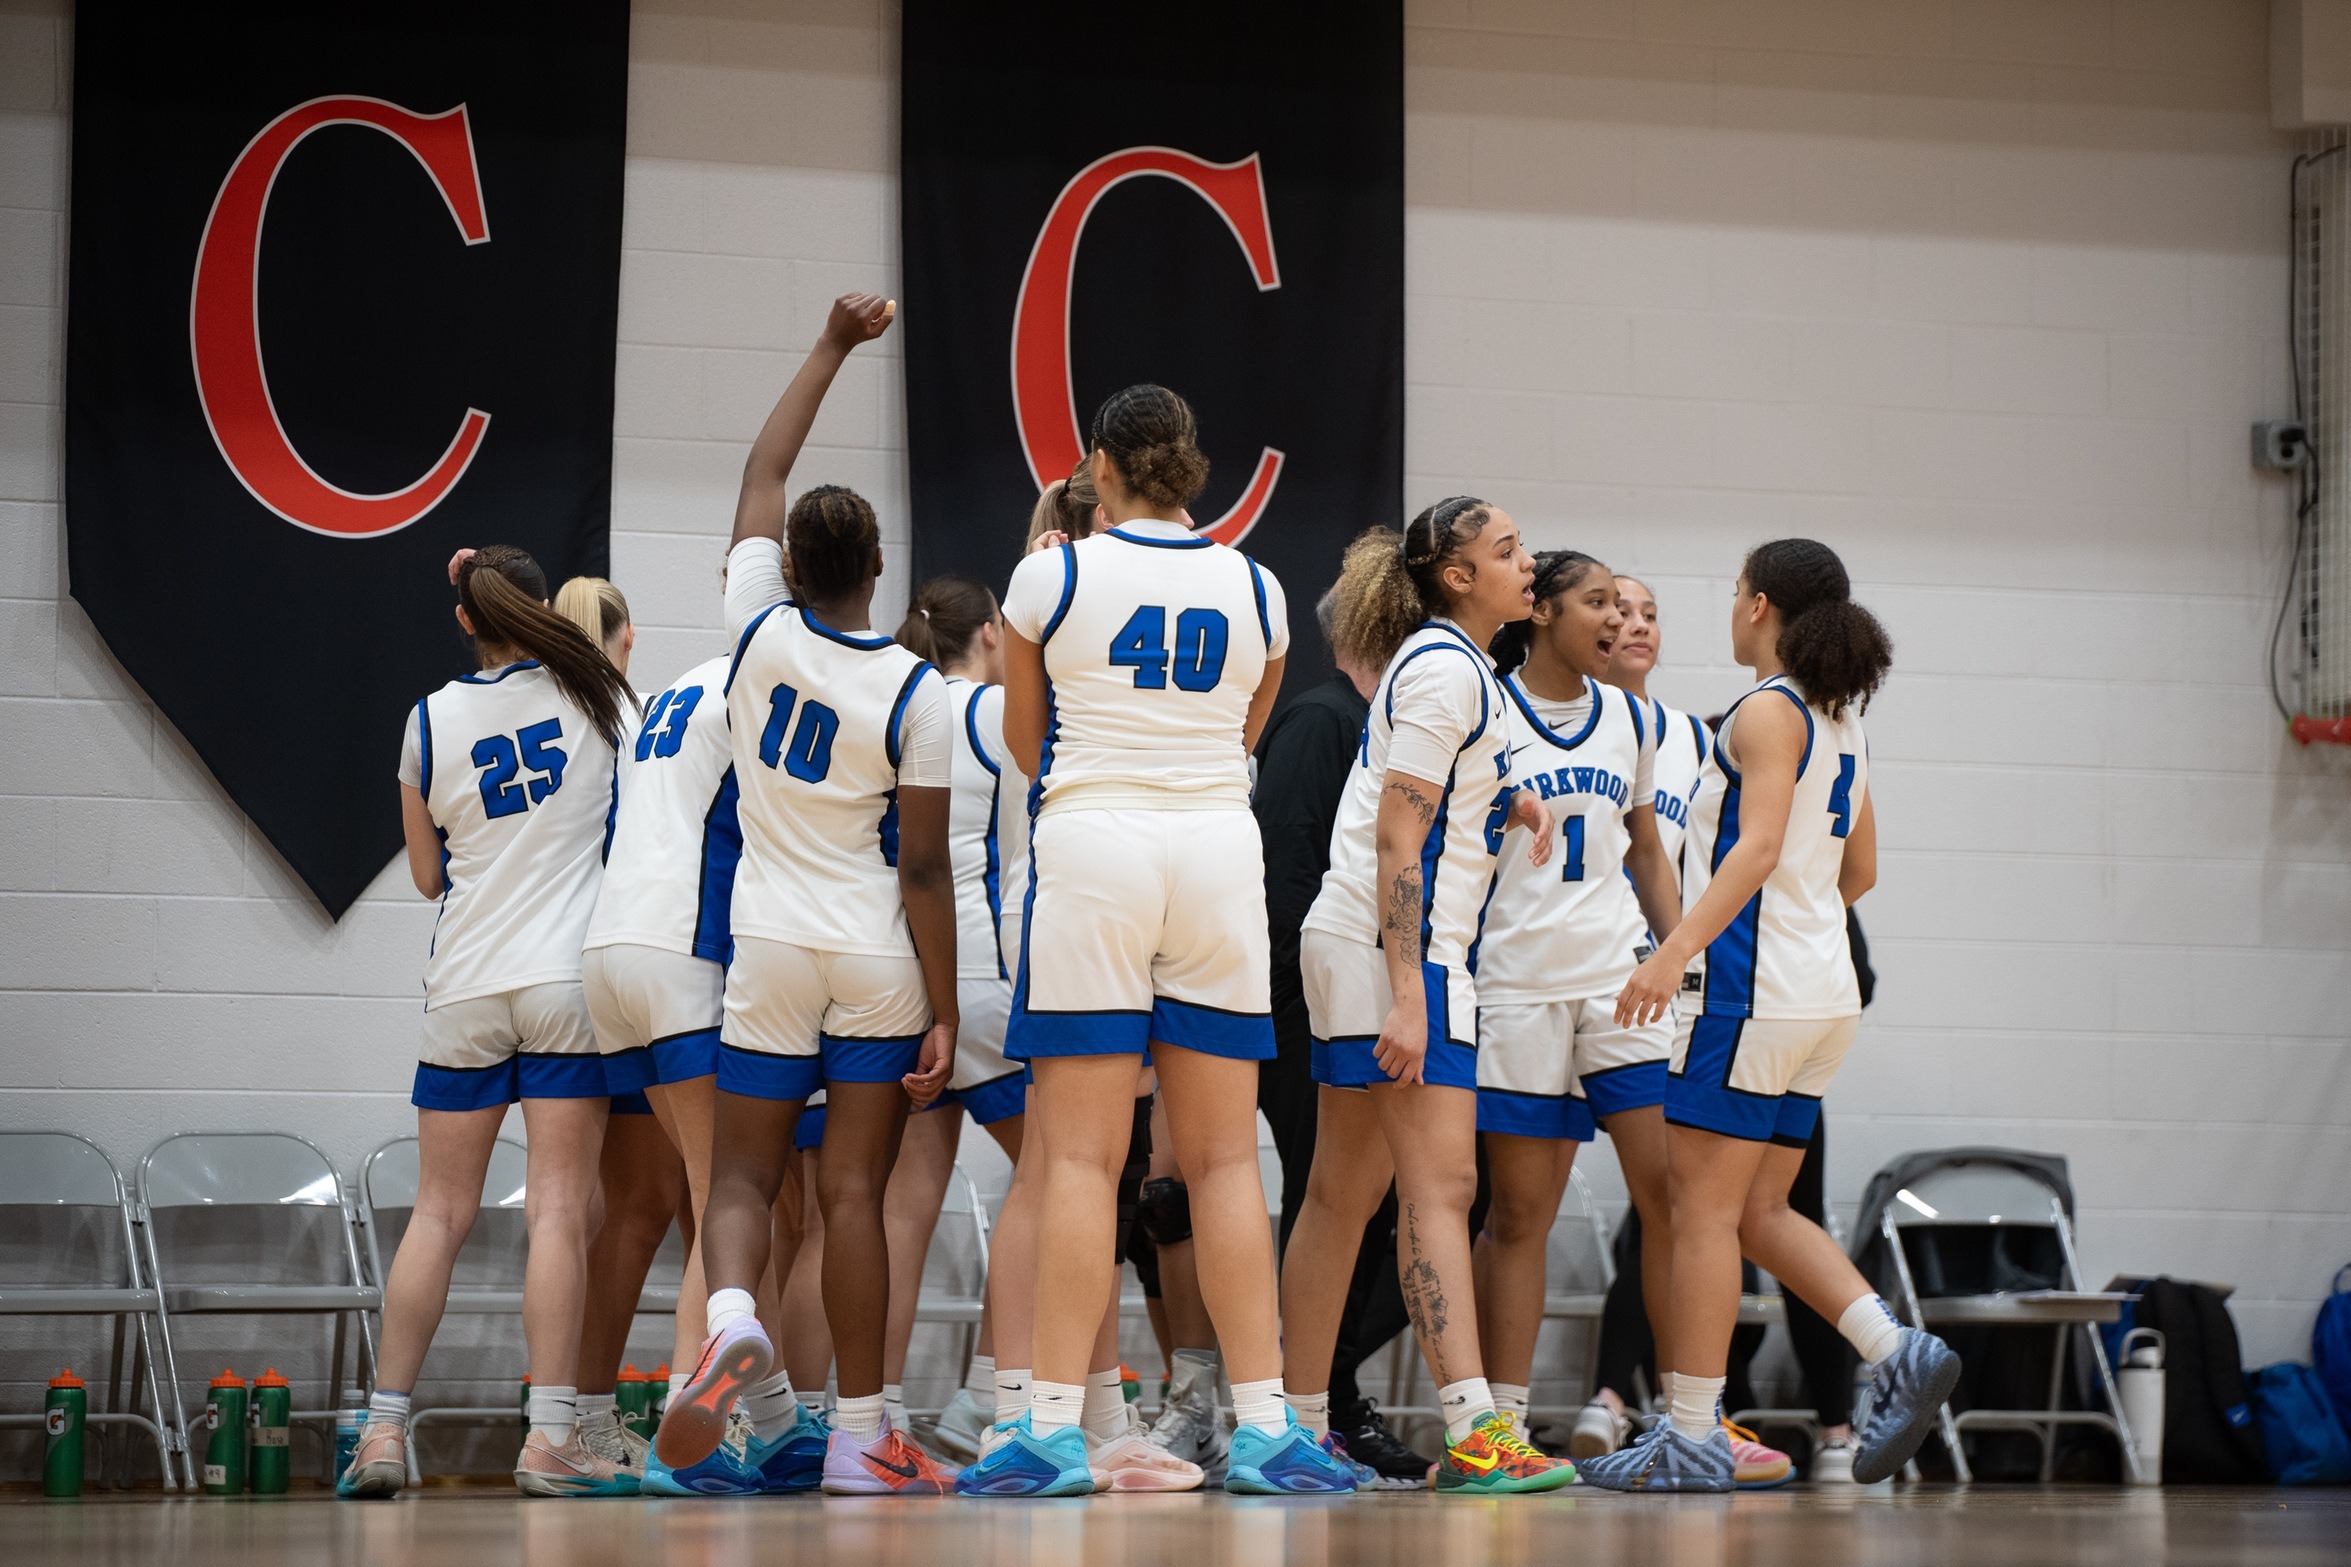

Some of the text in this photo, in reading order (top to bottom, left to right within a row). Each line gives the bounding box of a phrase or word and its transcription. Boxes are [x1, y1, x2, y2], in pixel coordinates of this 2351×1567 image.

[190, 94, 491, 539] C
[1010, 145, 1285, 549] C
[1109, 605, 1229, 693] 40
[470, 717, 568, 820] 25
[635, 685, 704, 762] 23
[759, 682, 840, 784] 10
[1562, 815, 1585, 882] 1
[46, 1407, 65, 1436] G
